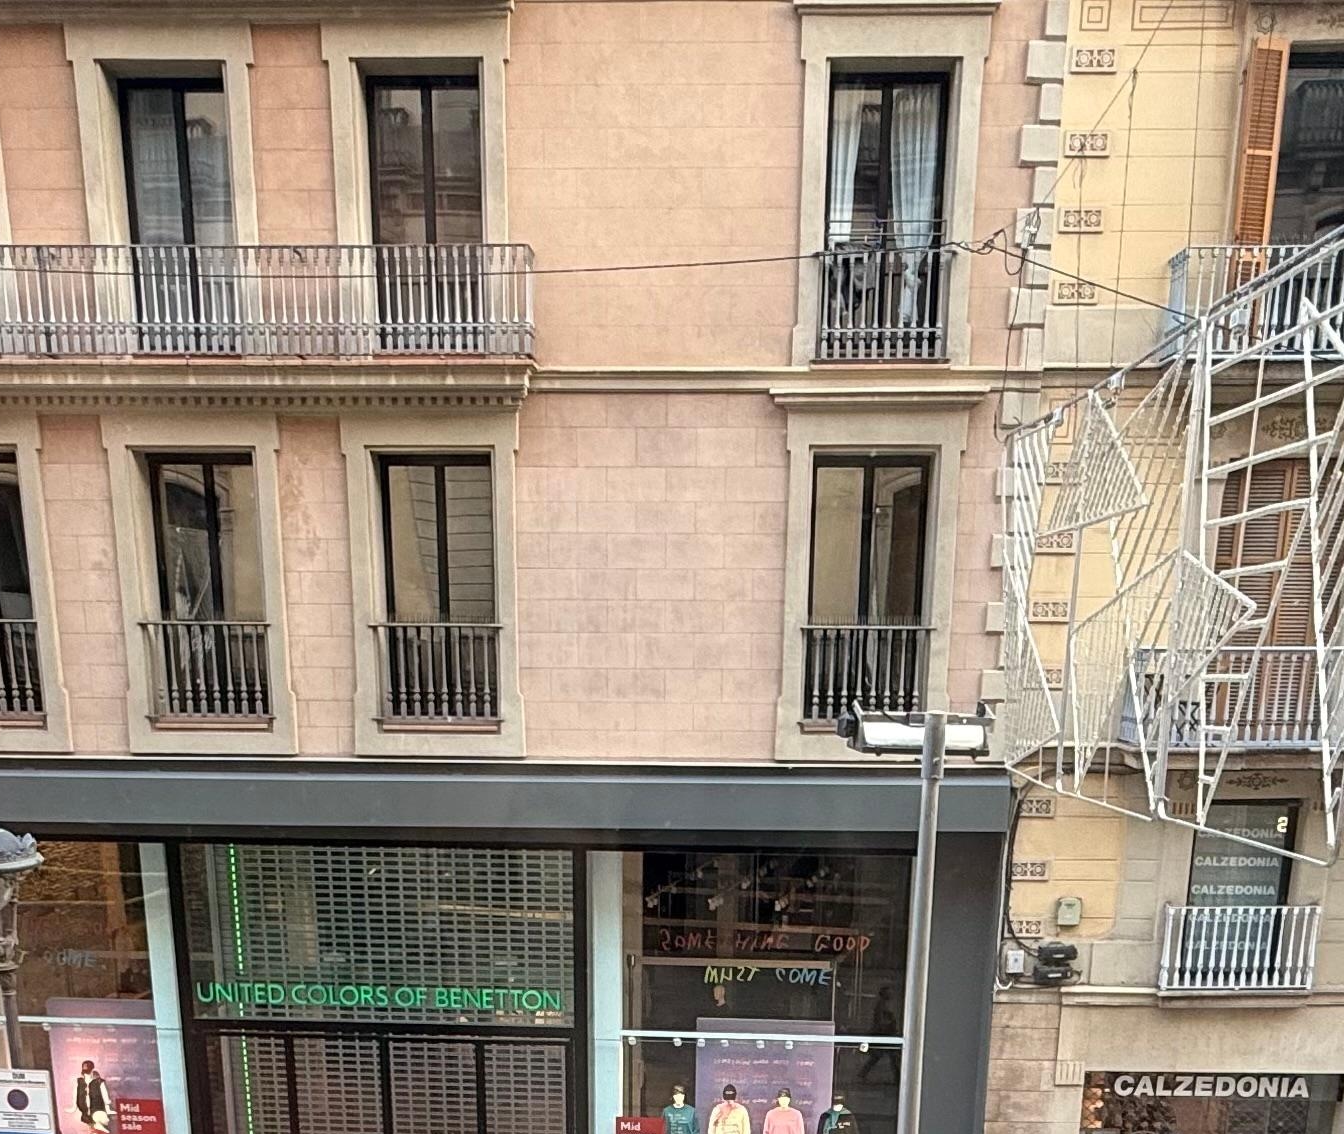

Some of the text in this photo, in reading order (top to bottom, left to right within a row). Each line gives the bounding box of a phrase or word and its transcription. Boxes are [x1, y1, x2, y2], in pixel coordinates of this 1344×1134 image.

[1195, 856, 1279, 867] CALZEDONIA
[1191, 885, 1275, 895] CALZEDONIA
[196, 982, 561, 1011] UNITED COLORS OF BENETTON
[1114, 1075, 1309, 1098] CALZEDONIA
[120, 1103, 140, 1112] Mid
[122, 1122, 142, 1130] sale
[620, 1122, 641, 1131] Mid
